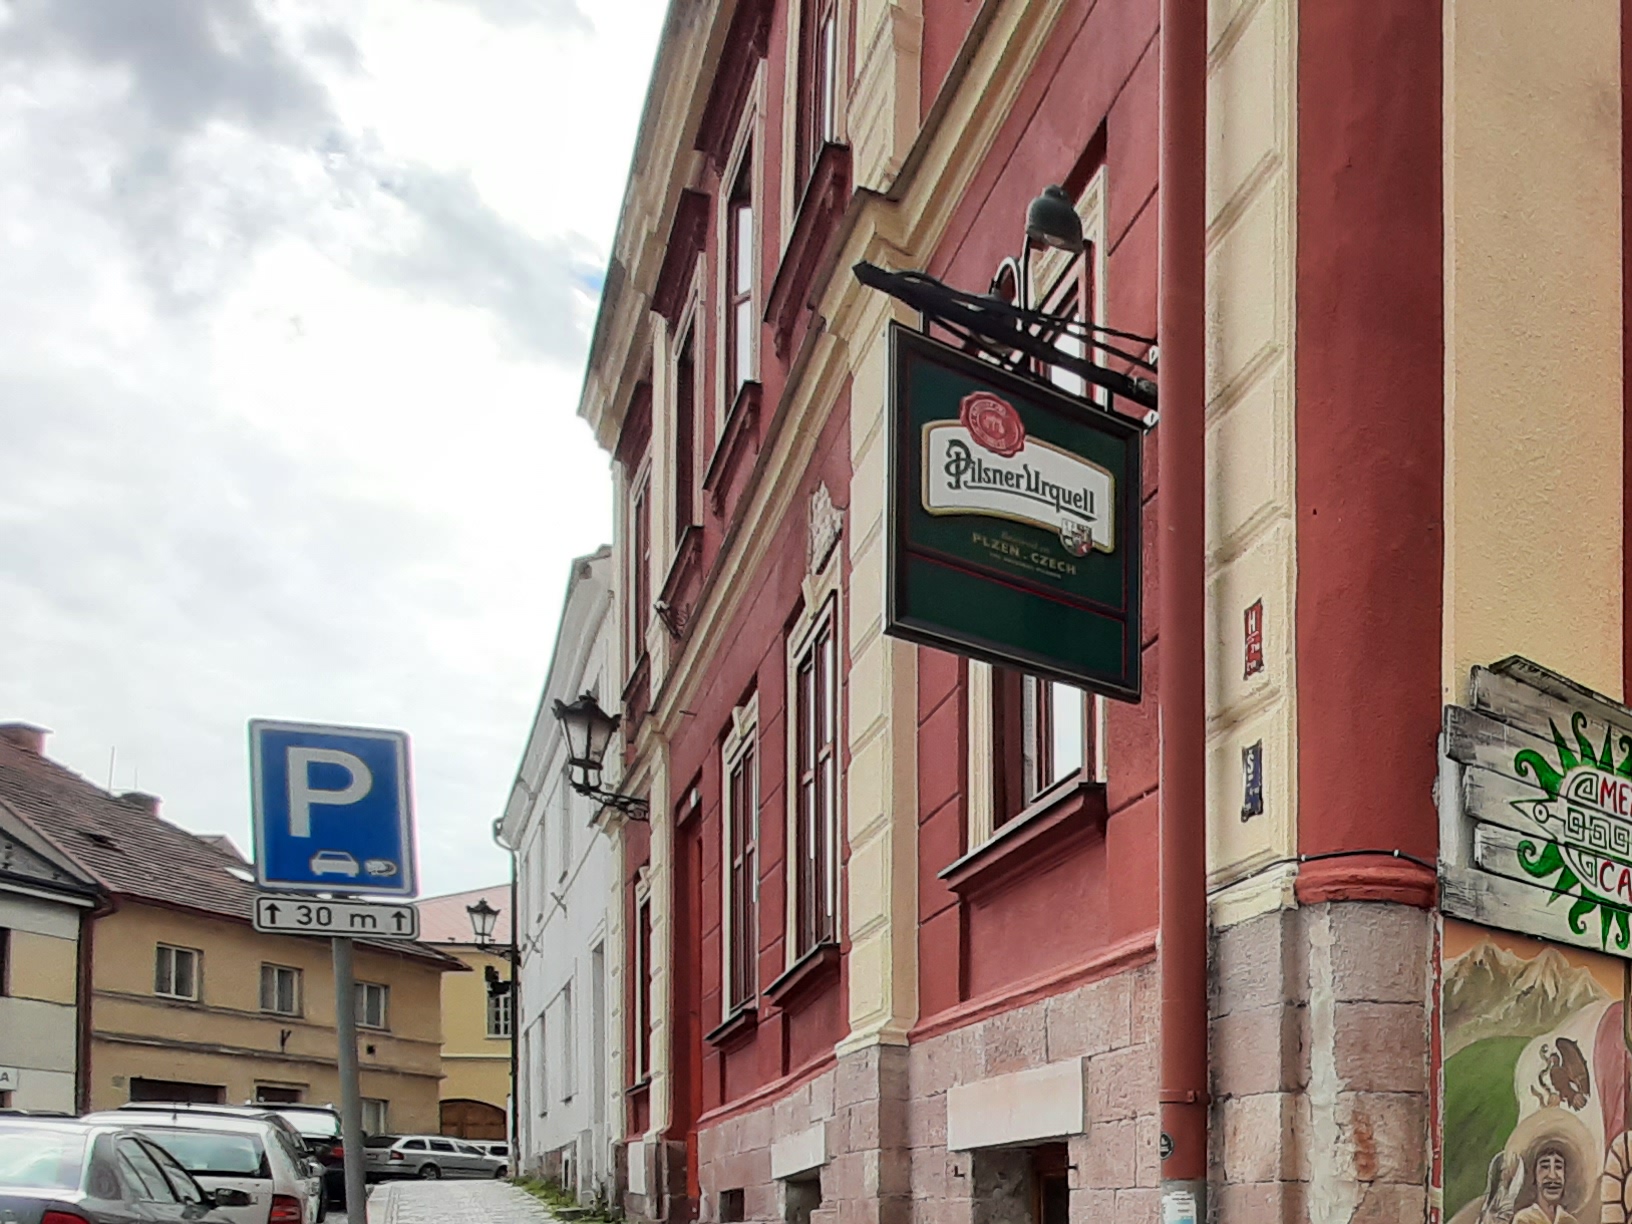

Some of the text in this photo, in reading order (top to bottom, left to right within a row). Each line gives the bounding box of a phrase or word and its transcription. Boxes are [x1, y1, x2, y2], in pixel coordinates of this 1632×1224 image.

[944, 439, 1095, 513] Pilsner Urquell
[1031, 552, 1077, 575] CZECH
[287, 746, 373, 838] P
[297, 905, 377, 929] 30 m
